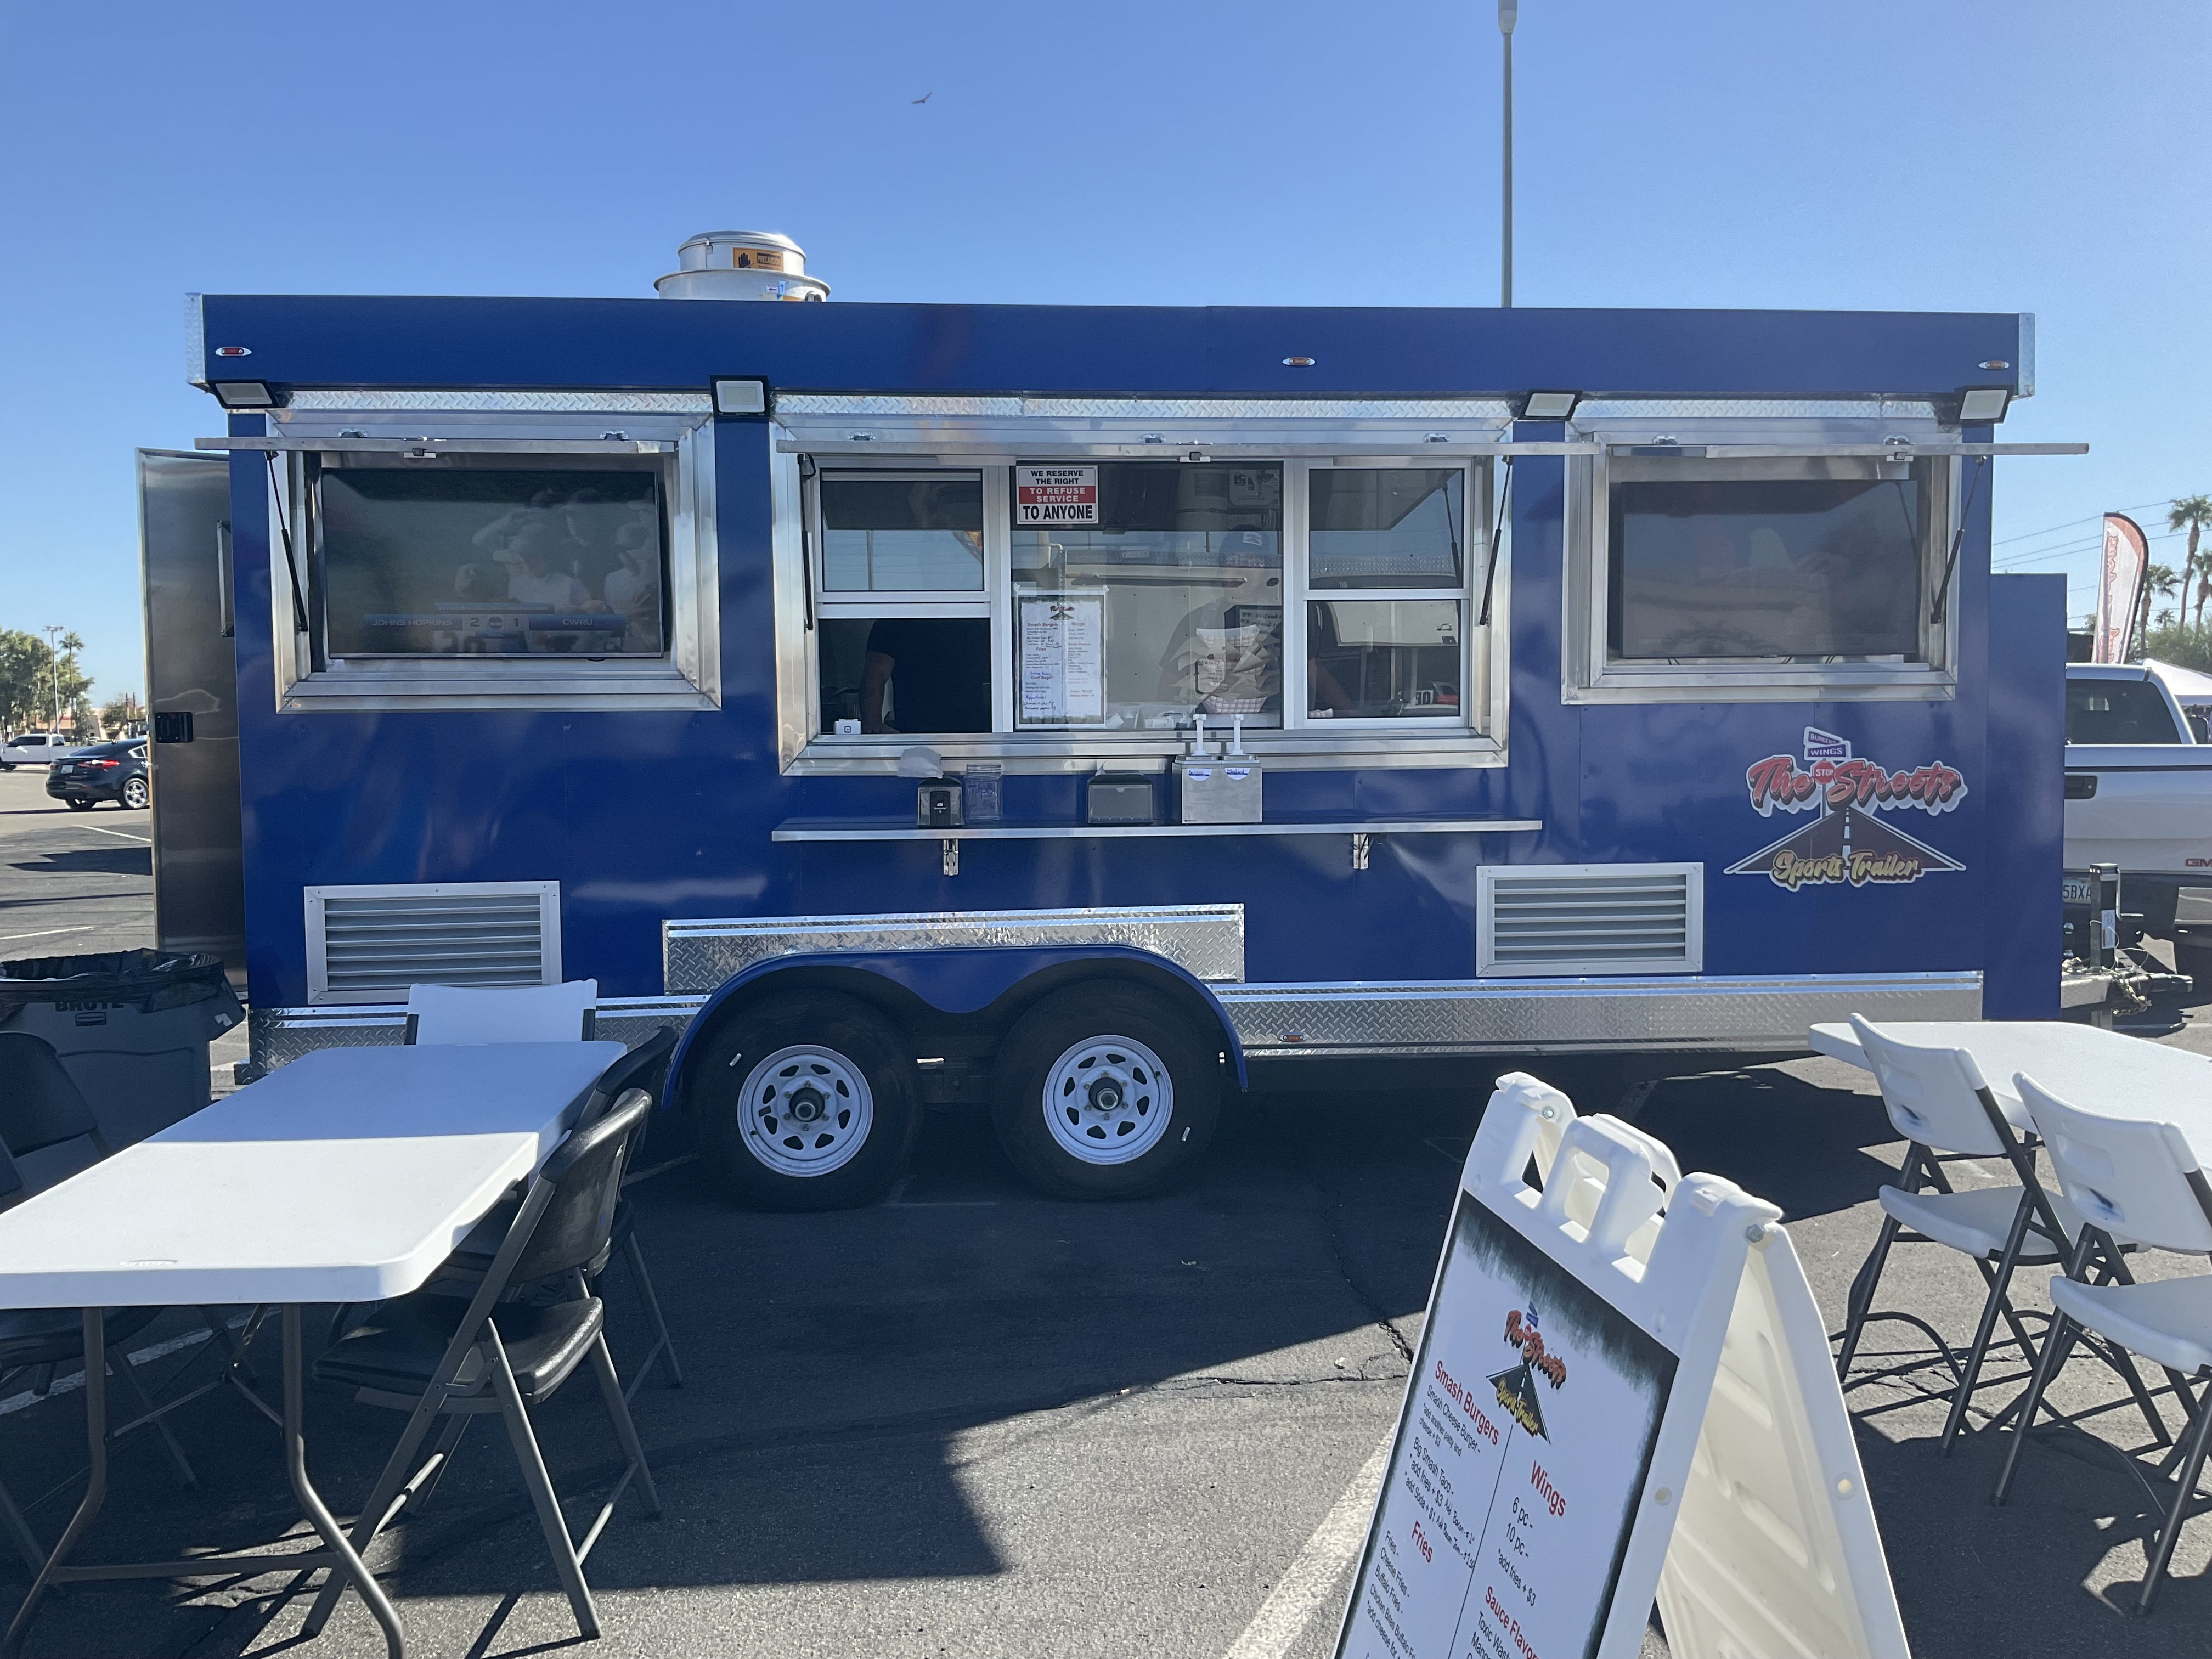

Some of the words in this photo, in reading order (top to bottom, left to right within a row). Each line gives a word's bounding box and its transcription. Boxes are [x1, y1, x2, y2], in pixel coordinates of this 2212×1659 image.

[1023, 505, 1040, 520] TO
[1043, 505, 1093, 520] ANYONE
[470, 617, 480, 627] 2
[513, 617, 519, 627] 1
[1810, 747, 1843, 756] WINGS
[1815, 768, 1834, 777] STOP
[1749, 757, 1816, 810] The
[1826, 760, 1962, 811] Streets
[1773, 850, 1843, 889] Sports
[1848, 851, 1921, 882] Trailer
[2185, 858, 2212, 867] GM
[1427, 1385, 1443, 1410] Smash
[1443, 1403, 1461, 1432] Cheese
[1460, 1424, 1478, 1452] Burger
[1435, 1360, 1463, 1405] Smash
[1463, 1391, 1499, 1446] Burgers
[1411, 1460, 1421, 1477] add
[1420, 1470, 1431, 1492] fries
[1435, 1489, 1443, 1507] $3
[1414, 1436, 1422, 1458] Big
[1422, 1448, 1438, 1477] Smash
[1439, 1468, 1451, 1493] Taco
[1406, 1477, 1415, 1493] add
[1414, 1486, 1425, 1509] Soda
[1429, 1507, 1436, 1522] $1
[1531, 1460, 1566, 1517] Wings
[1513, 1497, 1519, 1514] 6
[1517, 1507, 1529, 1526] pc
[1385, 1530, 1397, 1554] Fries
[1411, 1520, 1432, 1563] Fries
[1506, 1522, 1515, 1542] 10
[1514, 1536, 1525, 1555] pc
[1375, 1564, 1390, 1594] Buffalo
[1389, 1587, 1401, 1612] Fries
[1380, 1547, 1396, 1578] Cheese
[1396, 1571, 1407, 1595] Fries
[1509, 1565, 1522, 1589] fries
[1527, 1587, 1536, 1606] $3
[1370, 1584, 1385, 1614] Chicken
[1385, 1607, 1395, 1630] Bites
[1394, 1623, 1409, 1654] Buffalo
[1375, 1619, 1391, 1648] cheese
[1478, 1610, 1493, 1642] Toxic
[1493, 1633, 1511, 1659] Was
[1485, 1585, 1509, 1629] Sauce
[1509, 1618, 1539, 1659] Flavo
[1471, 1631, 1491, 1659] Man
